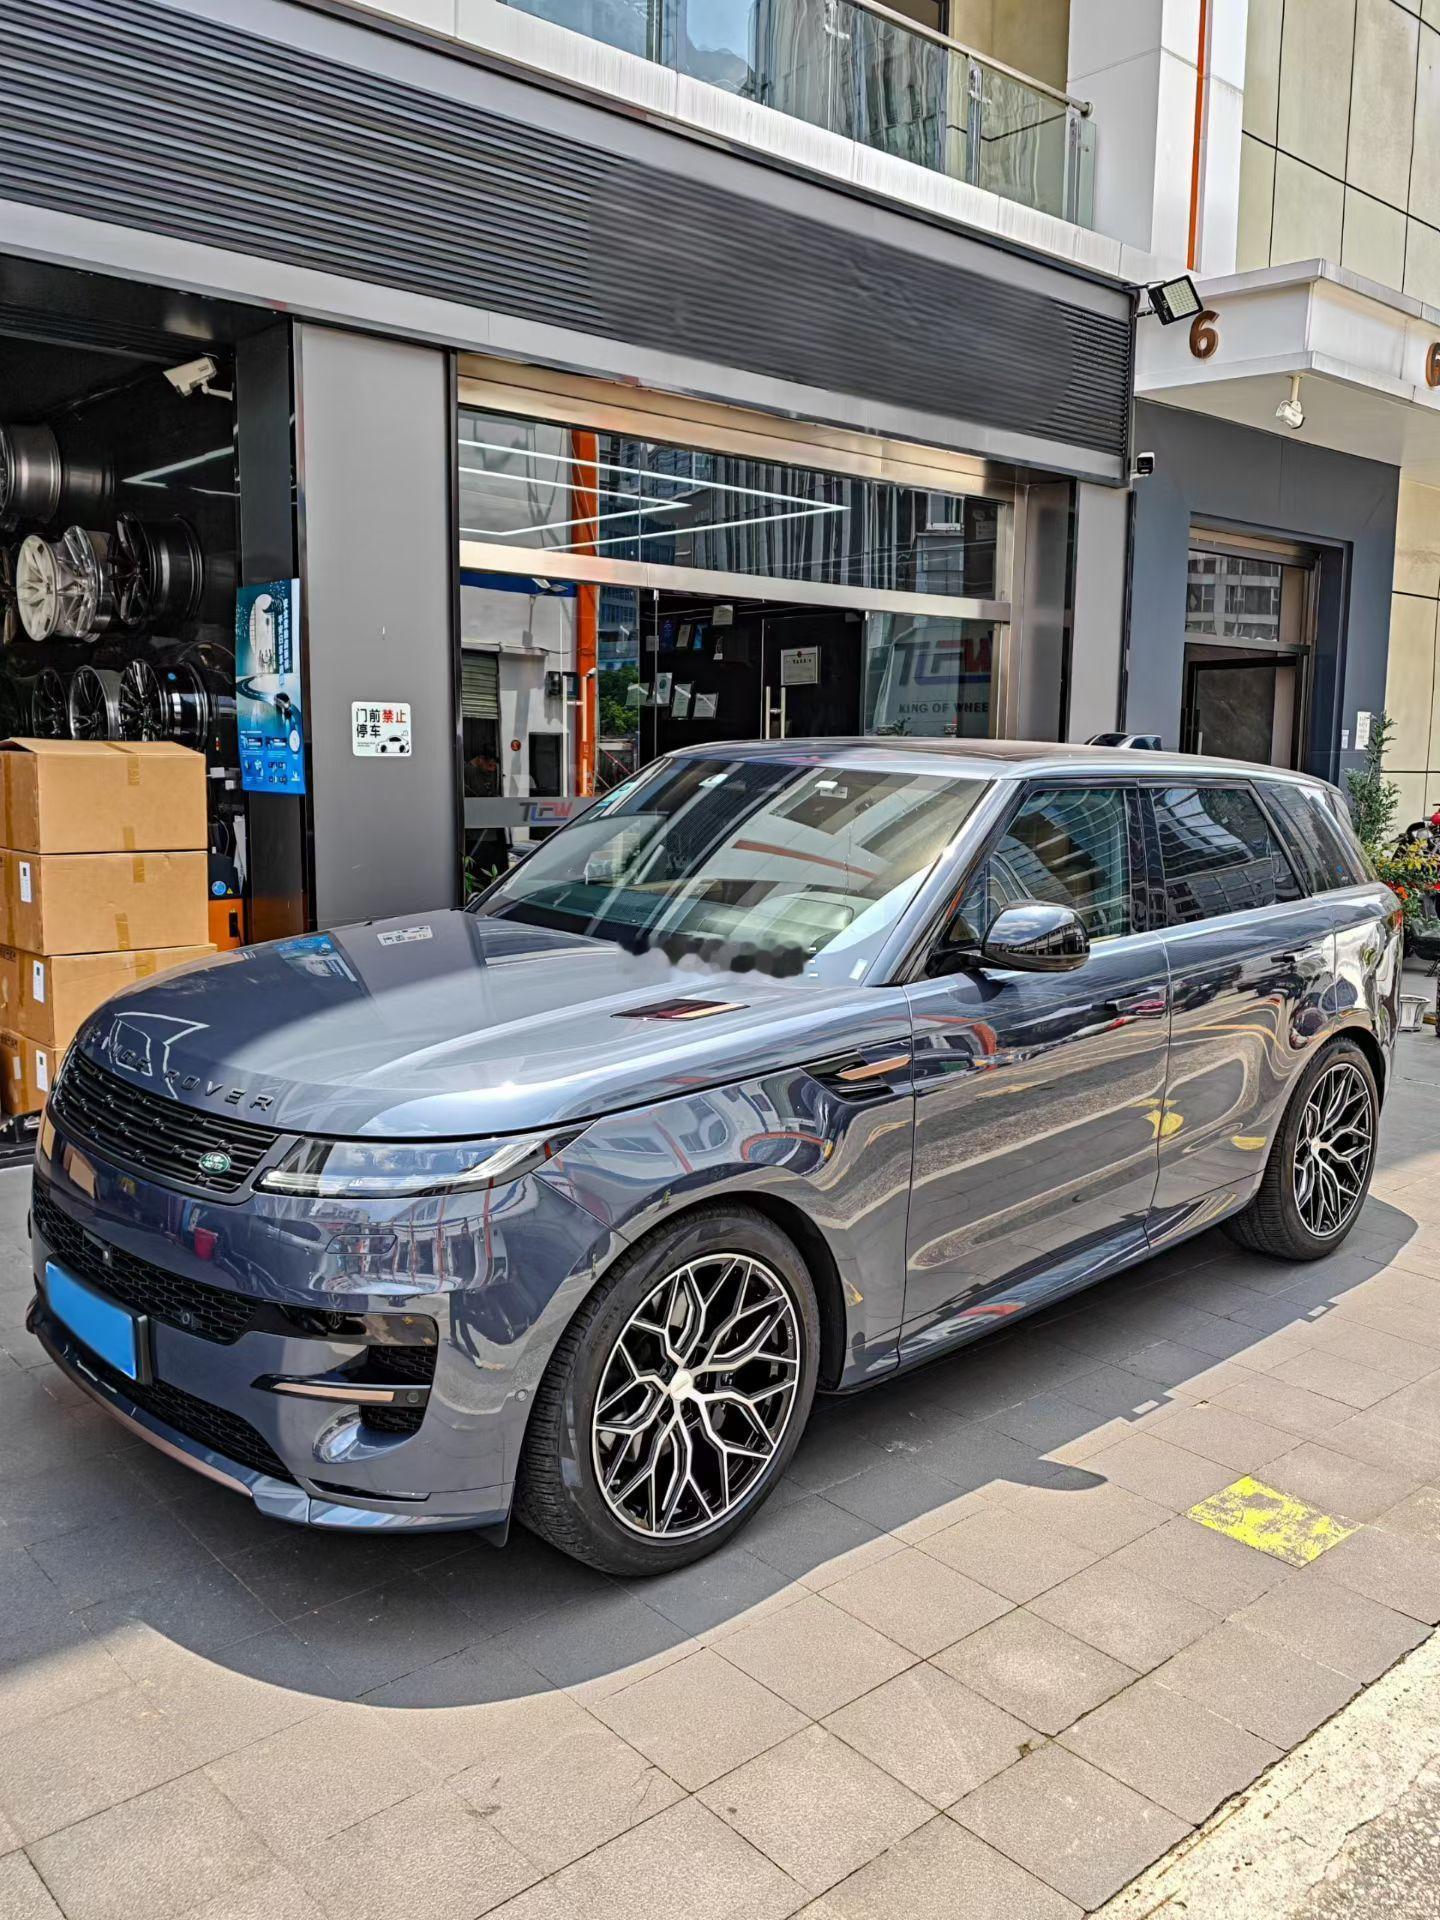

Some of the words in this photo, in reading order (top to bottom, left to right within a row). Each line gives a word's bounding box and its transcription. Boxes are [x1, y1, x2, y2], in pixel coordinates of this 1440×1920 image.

[1189, 309, 1220, 360] 6
[356, 708, 407, 723] 门前禁止
[898, 702, 928, 714] KING
[932, 702, 949, 714] OF
[356, 723, 381, 738] 停车
[164, 1069, 274, 1112] ROVER
